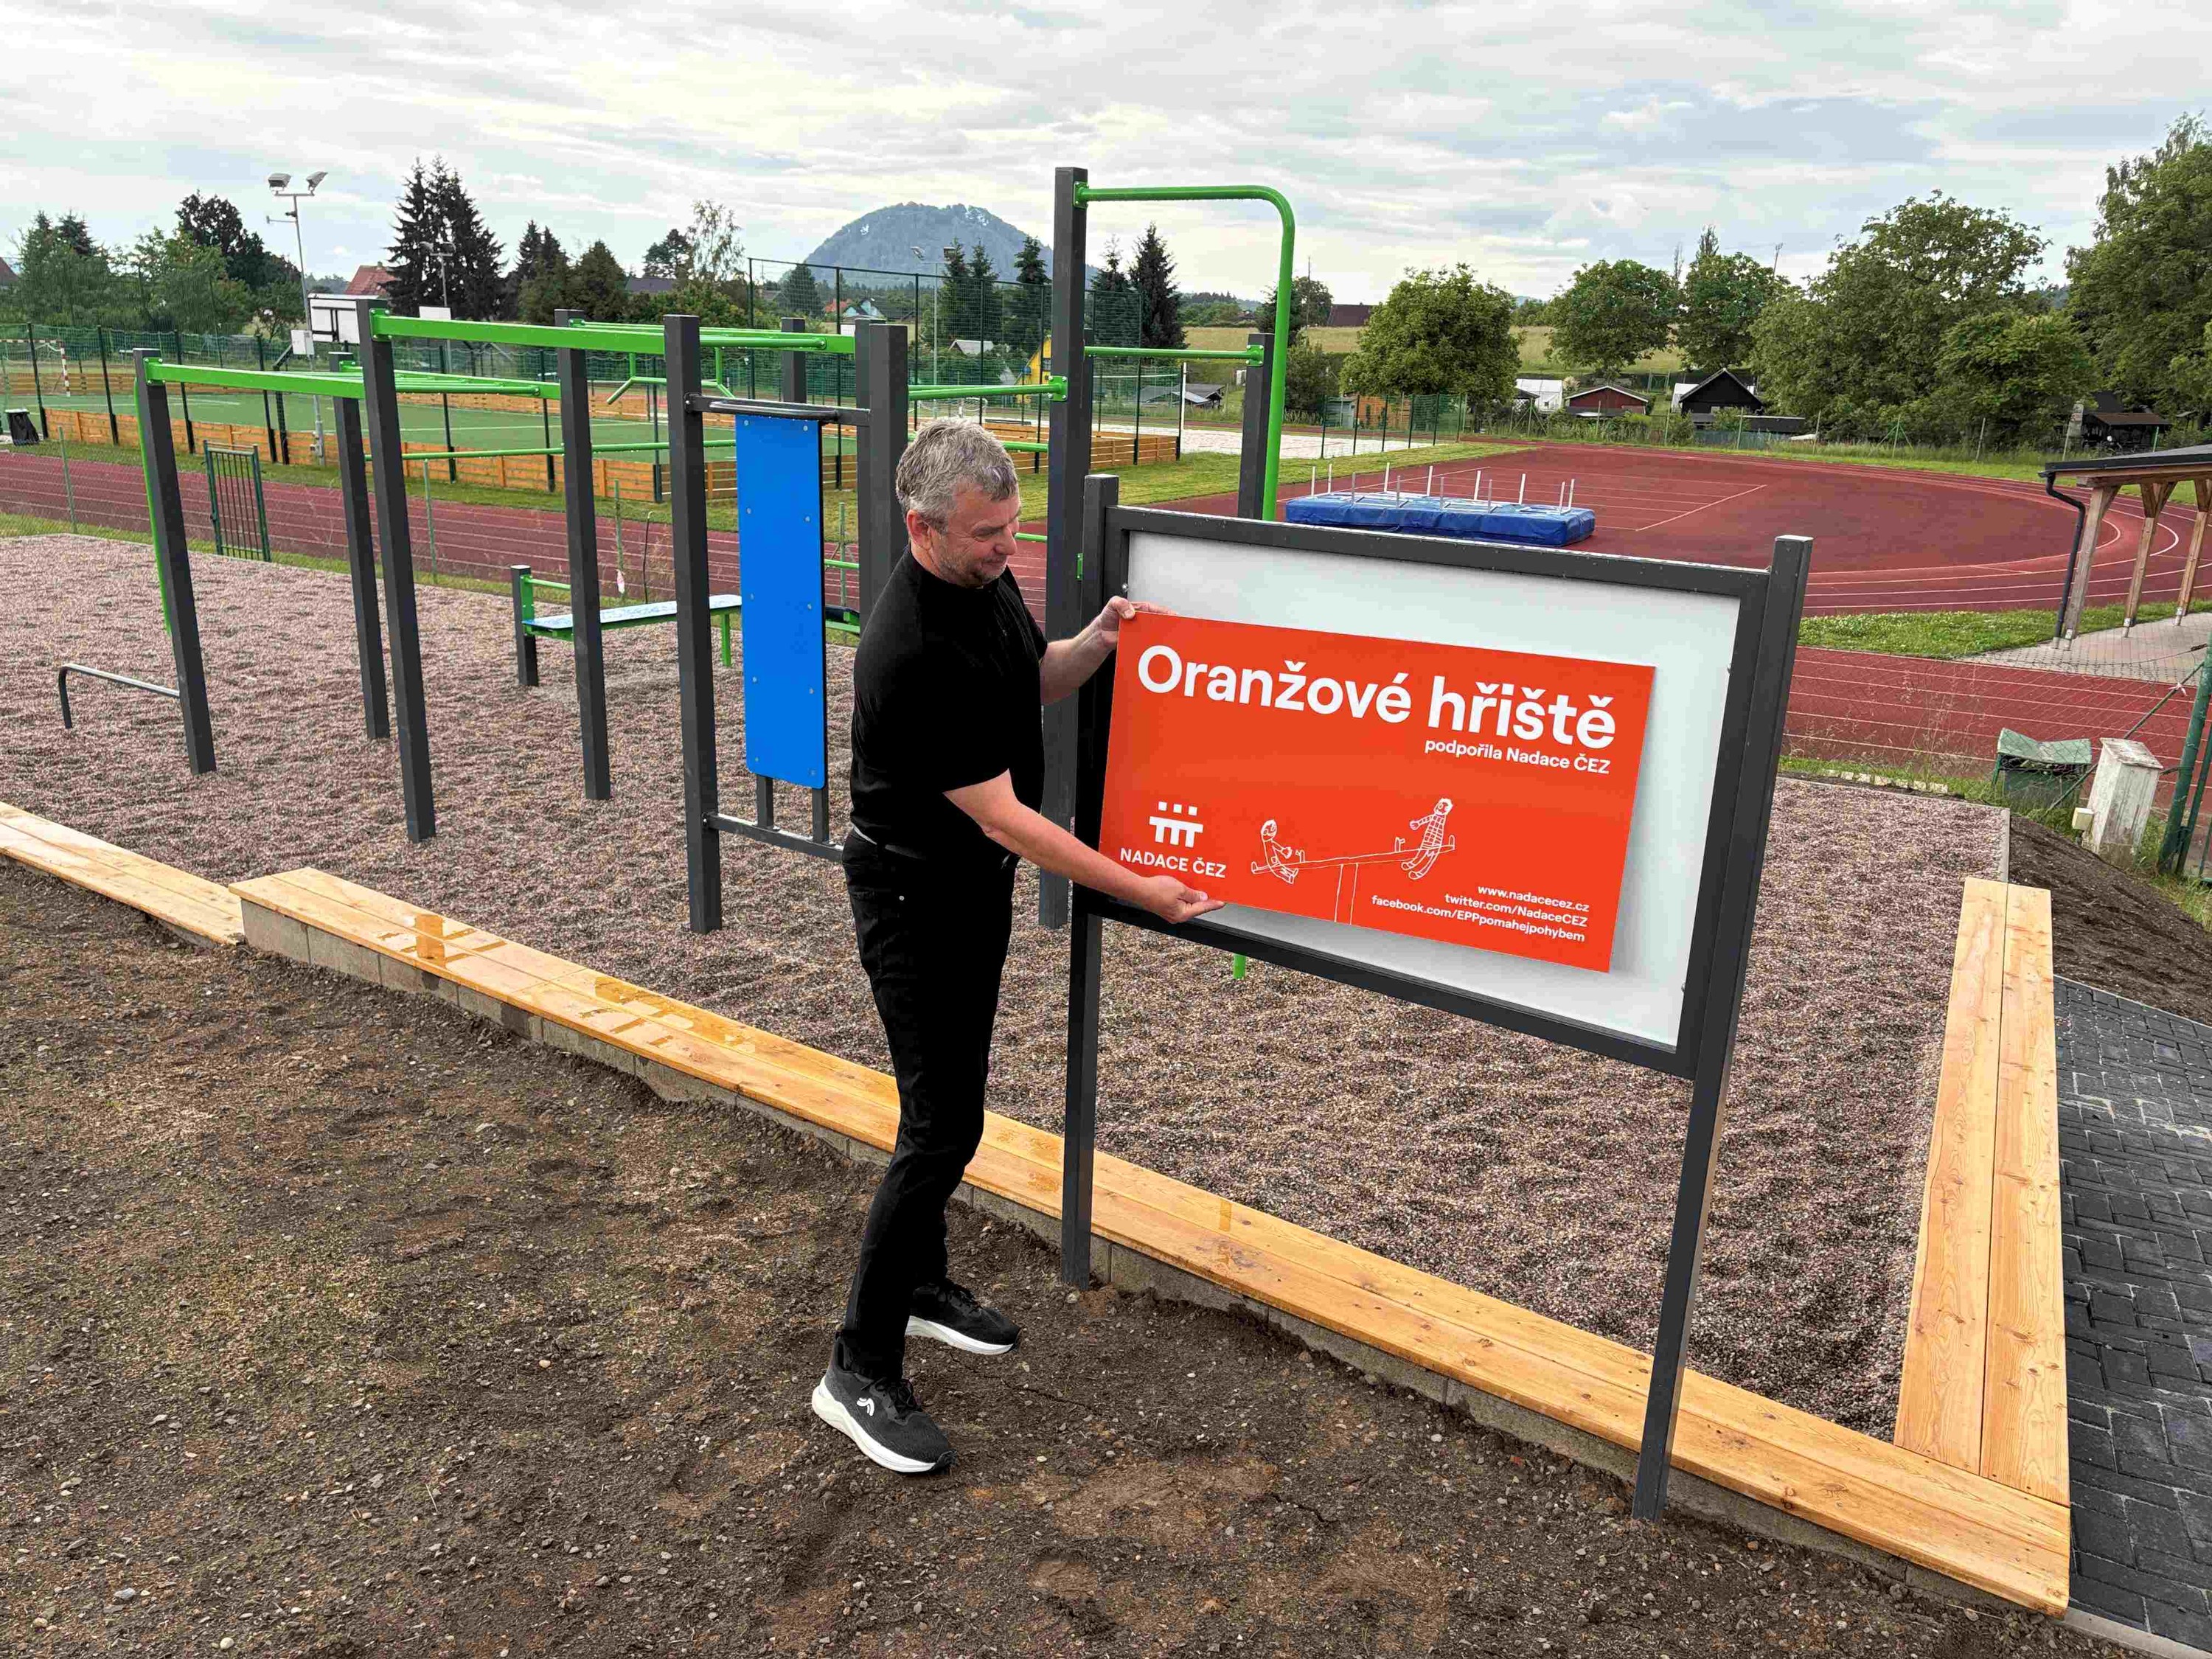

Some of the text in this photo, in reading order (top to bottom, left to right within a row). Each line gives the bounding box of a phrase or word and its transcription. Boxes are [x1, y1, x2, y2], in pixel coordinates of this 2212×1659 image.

[1138, 644, 1615, 749] Oranžové hřiště
[1425, 740, 1611, 774] podpořila Nadace ČEZ
[1120, 847, 1227, 878] NADACE ČEZ
[1444, 894, 1588, 928] twitter.com/NadaceCEZ
[1478, 886, 1590, 912] www.nadacecez.cz
[1371, 894, 1585, 942] facebook.com/EPPpomahejpohybem
